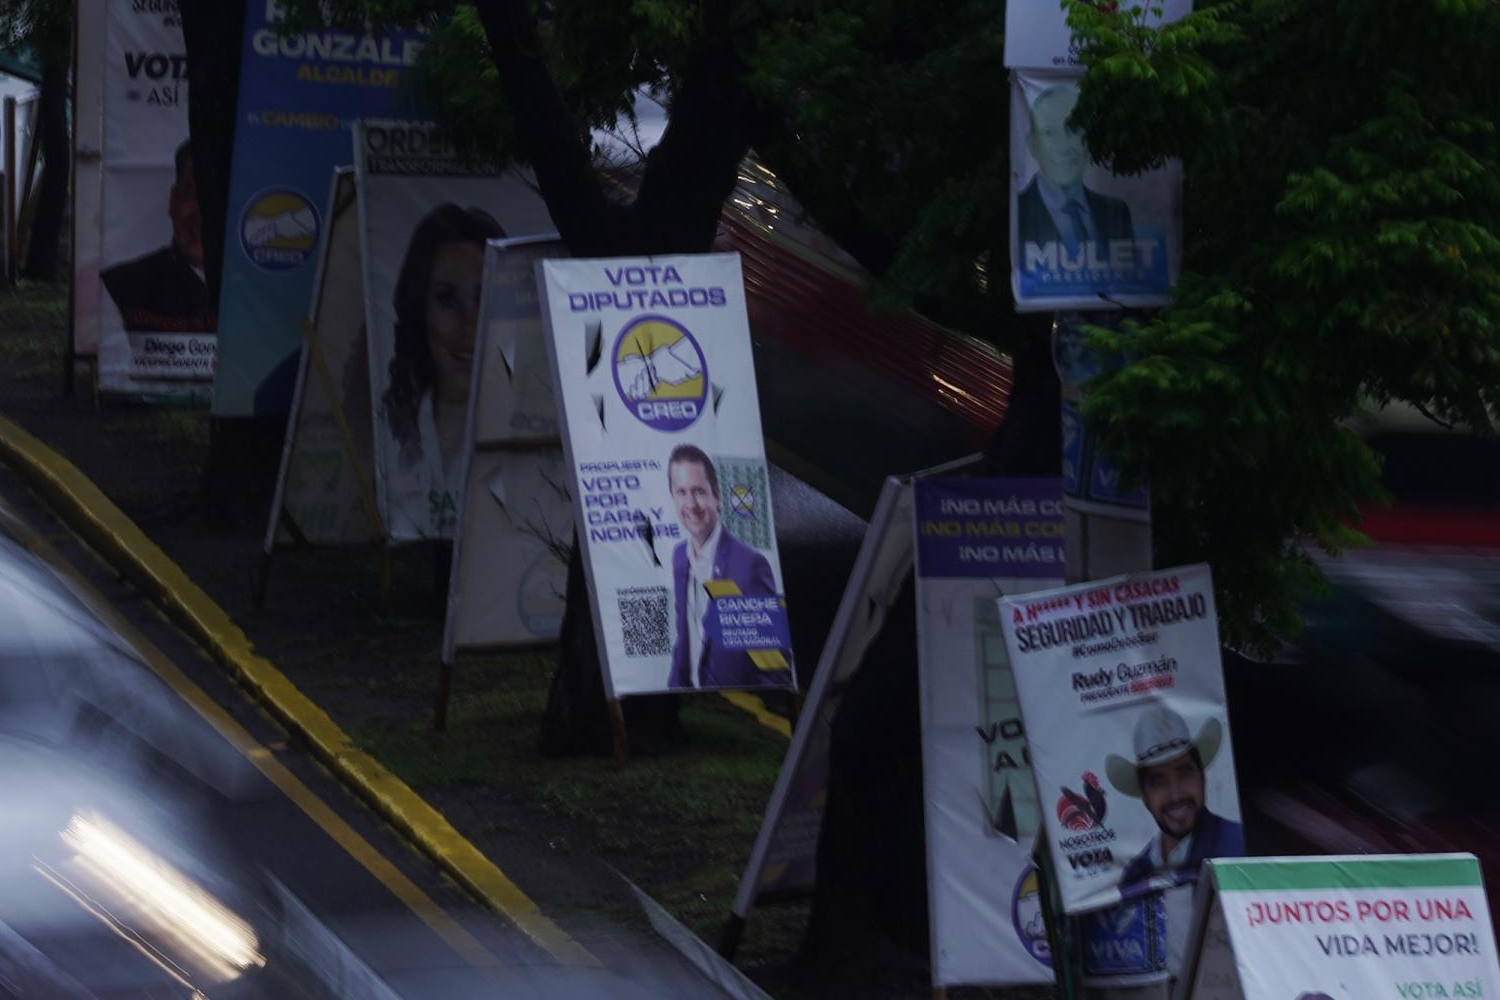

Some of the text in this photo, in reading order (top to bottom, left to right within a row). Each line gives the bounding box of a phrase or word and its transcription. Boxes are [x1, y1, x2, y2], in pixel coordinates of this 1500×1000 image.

[296, 64, 399, 88] ALCALDE
[261, 110, 340, 131] CAMBIO
[1024, 238, 1159, 273] MULET
[605, 266, 683, 286] VOTA
[568, 287, 727, 312] DIPUTADOS
[144, 337, 185, 357] Diego
[637, 401, 697, 420] CREO
[581, 475, 640, 491] VOTO
[585, 493, 628, 508] POR
[984, 495, 1036, 516] MÁS
[588, 507, 662, 525] CARA Y
[966, 517, 1021, 537] MÁS
[1002, 542, 1056, 562] MÁS
[1012, 607, 1024, 624] A
[1073, 593, 1084, 612] Y
[1086, 588, 1111, 609] SIN
[1114, 575, 1180, 602] CASACAS
[719, 612, 772, 626] RIVERA
[1016, 592, 1206, 653] SEGURIDAD Y TRABAJO
[1071, 667, 1114, 692] Rudy
[1116, 654, 1178, 682] Guzmán
[1058, 828, 1117, 850] NOSOTROS
[1246, 898, 1474, 927] ¡JUNTOS POR UNA
[1090, 938, 1144, 960] VIVA
[1316, 932, 1479, 956] VIDA MEJOR!
[1396, 976, 1483, 1000] VOTA ASÍ
